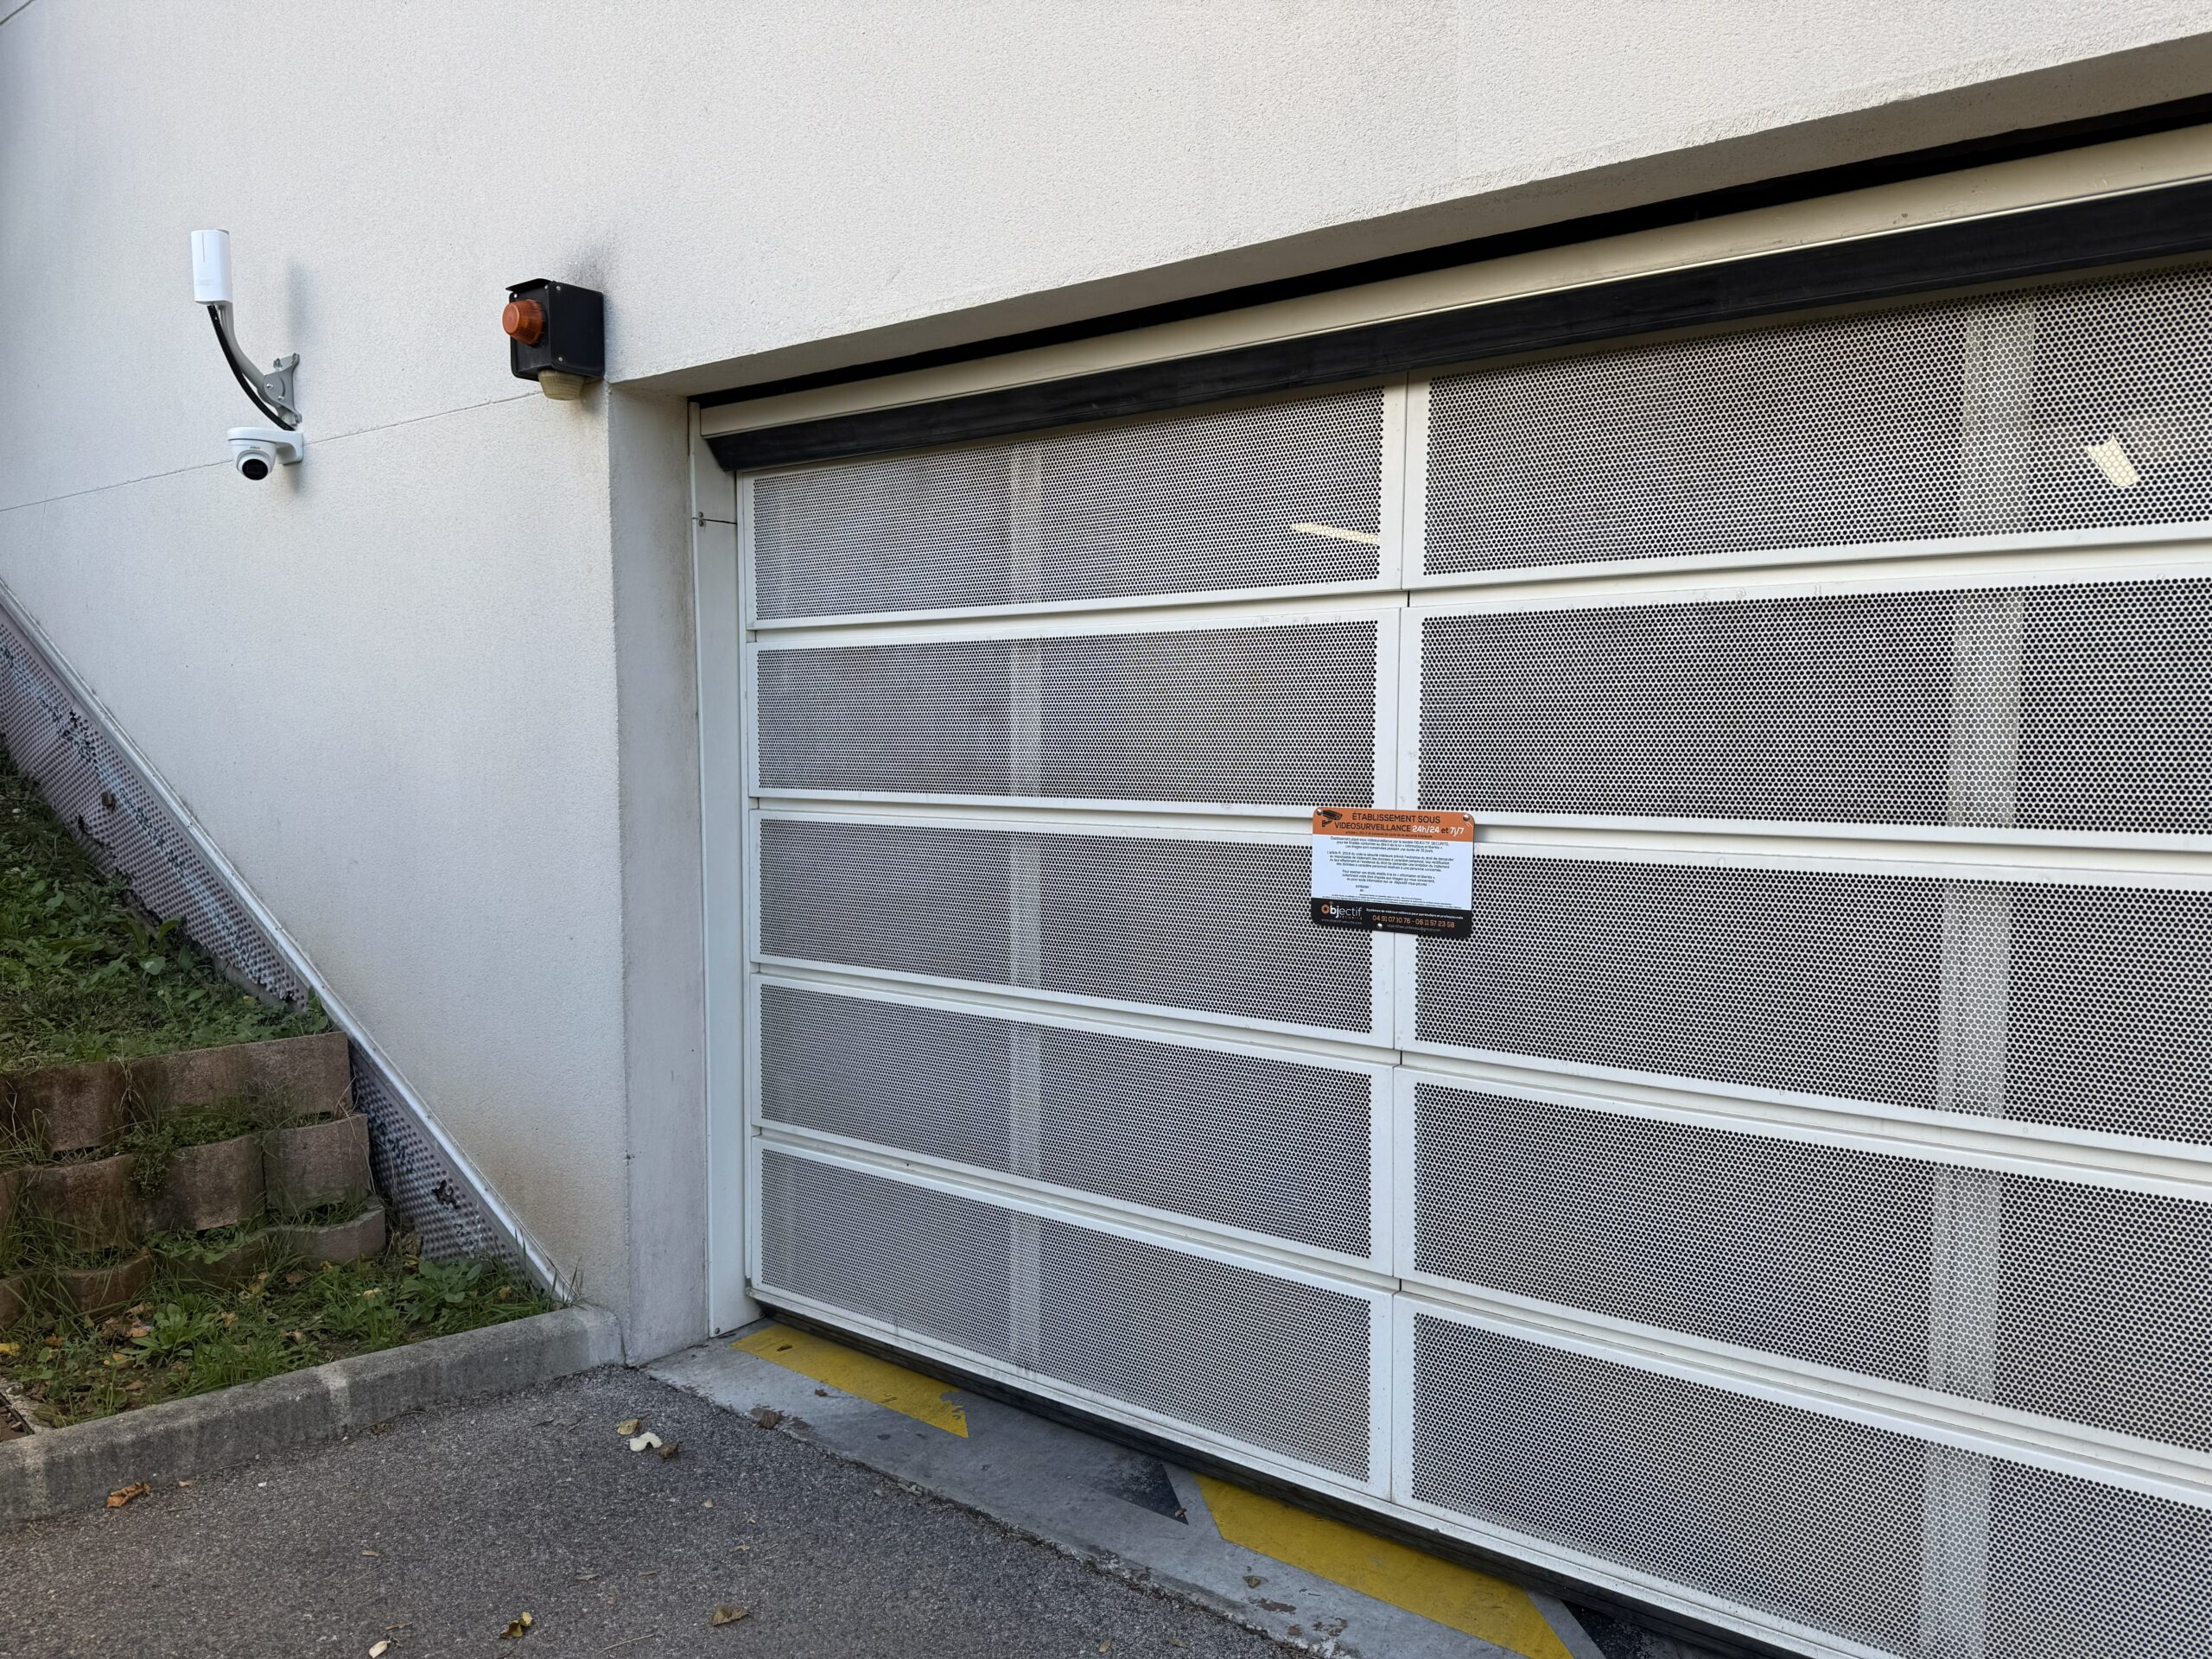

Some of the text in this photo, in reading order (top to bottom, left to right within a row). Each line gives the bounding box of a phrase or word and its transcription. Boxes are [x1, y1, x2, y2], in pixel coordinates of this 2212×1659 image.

[1352, 811, 1416, 823] ÉTABLISSEMENT
[1335, 822, 1411, 831] VIDEOSURVEILLANCE
[1412, 826, 1440, 834] 24h/24
[1450, 827, 1464, 837] 7j/7
